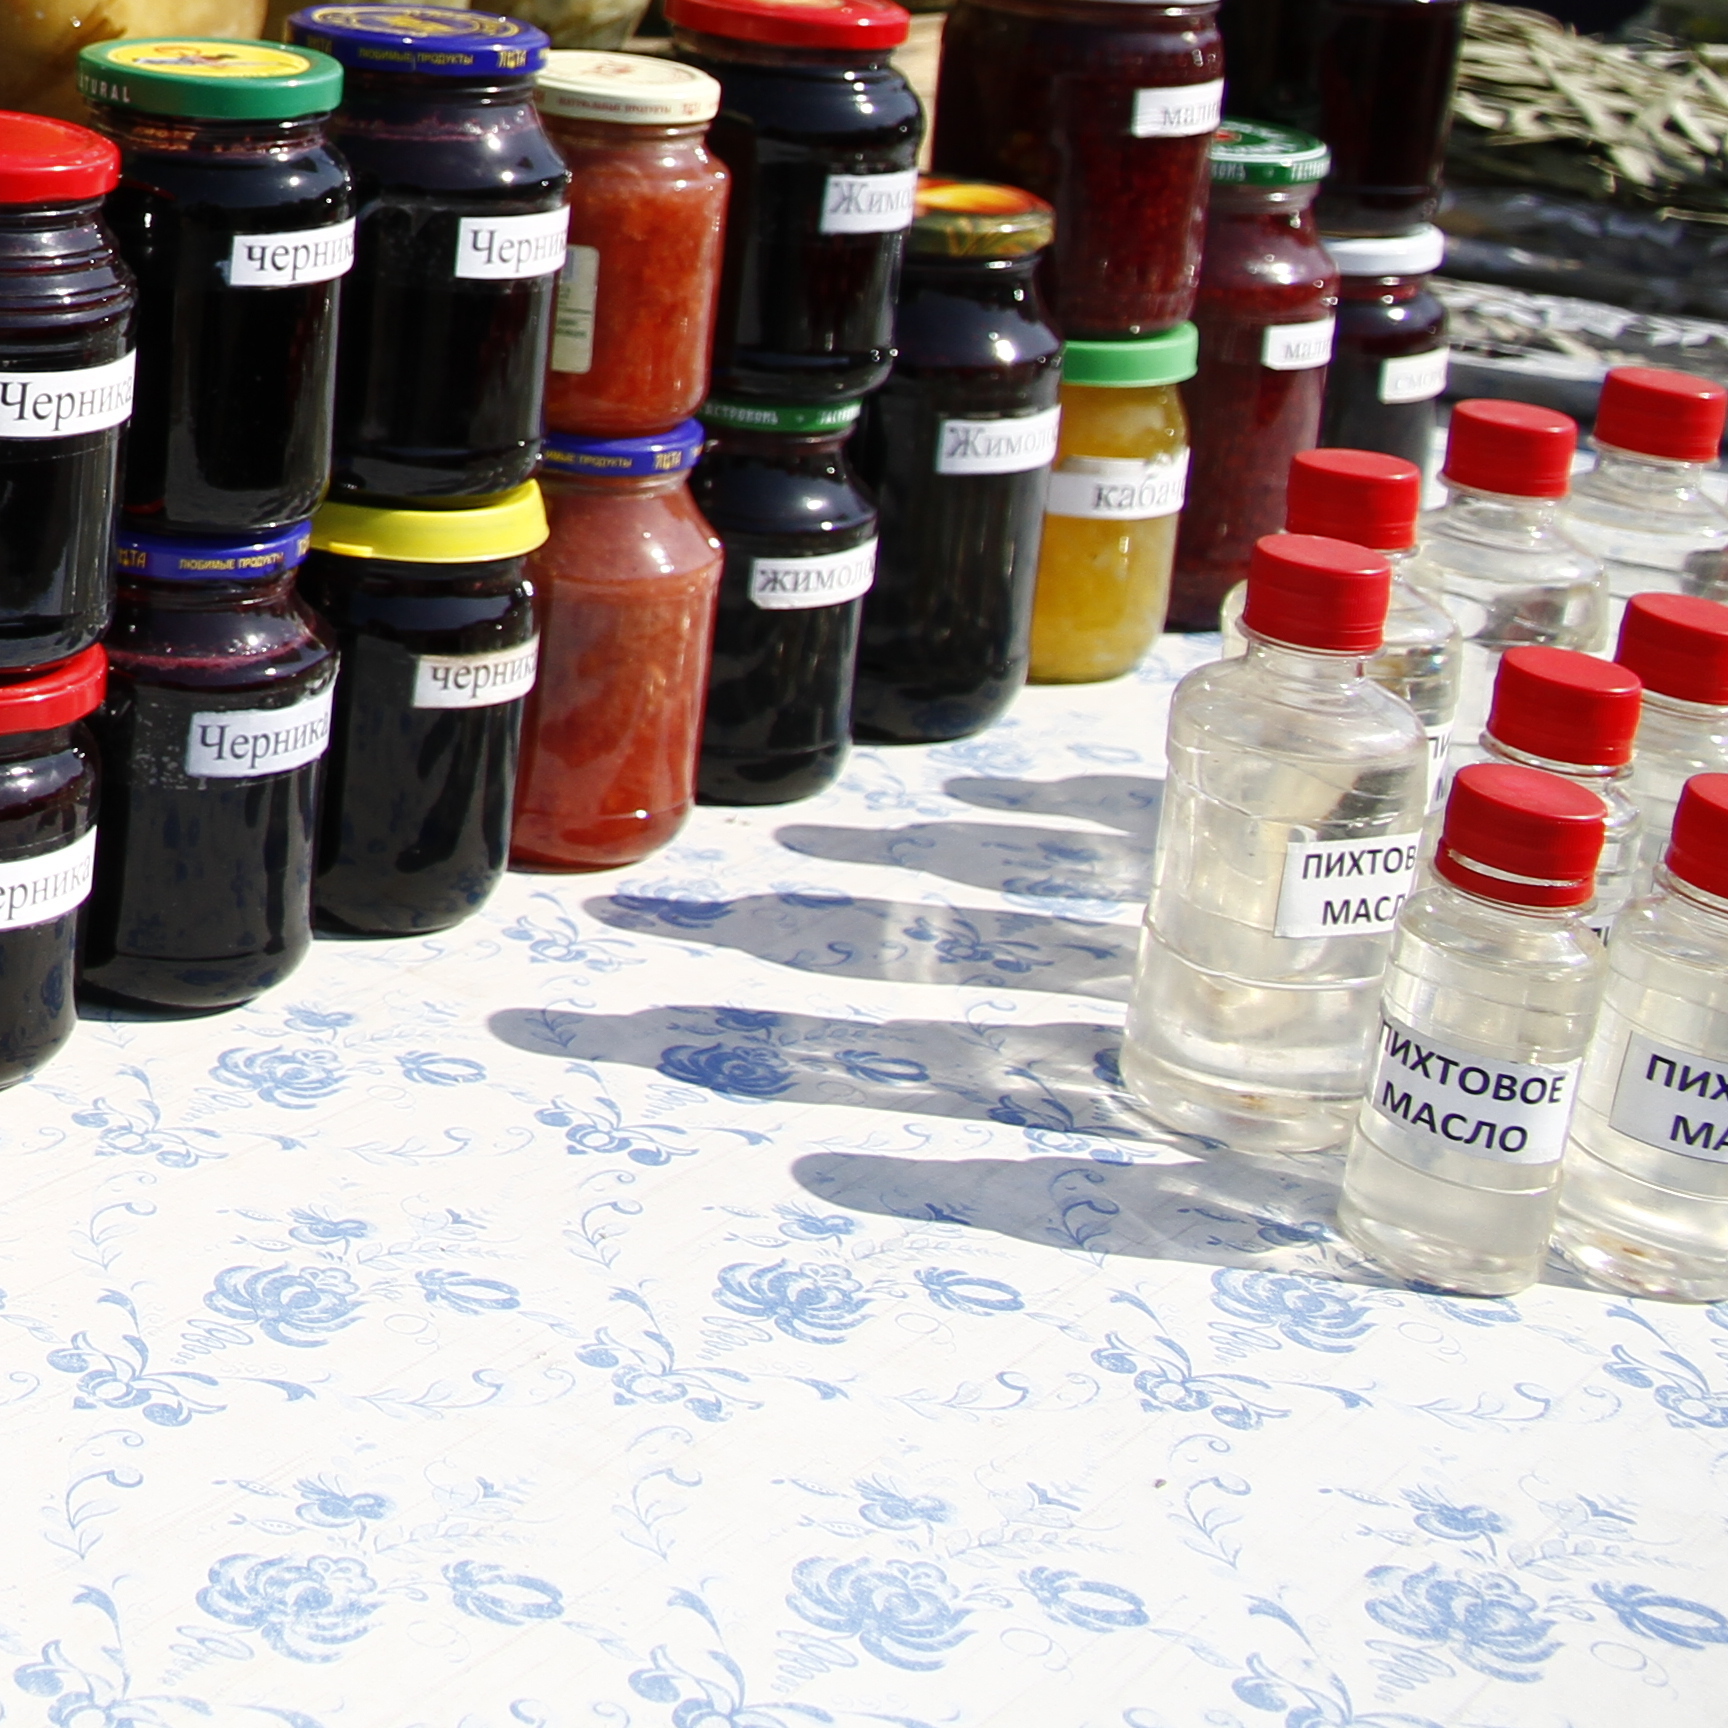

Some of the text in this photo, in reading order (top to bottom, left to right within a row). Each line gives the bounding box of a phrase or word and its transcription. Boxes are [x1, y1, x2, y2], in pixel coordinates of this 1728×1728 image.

[243, 233, 354, 281] черник
[1379, 1020, 1566, 1105] ПИХТОВОЕ
[1382, 1080, 1528, 1153] МАСЛО
